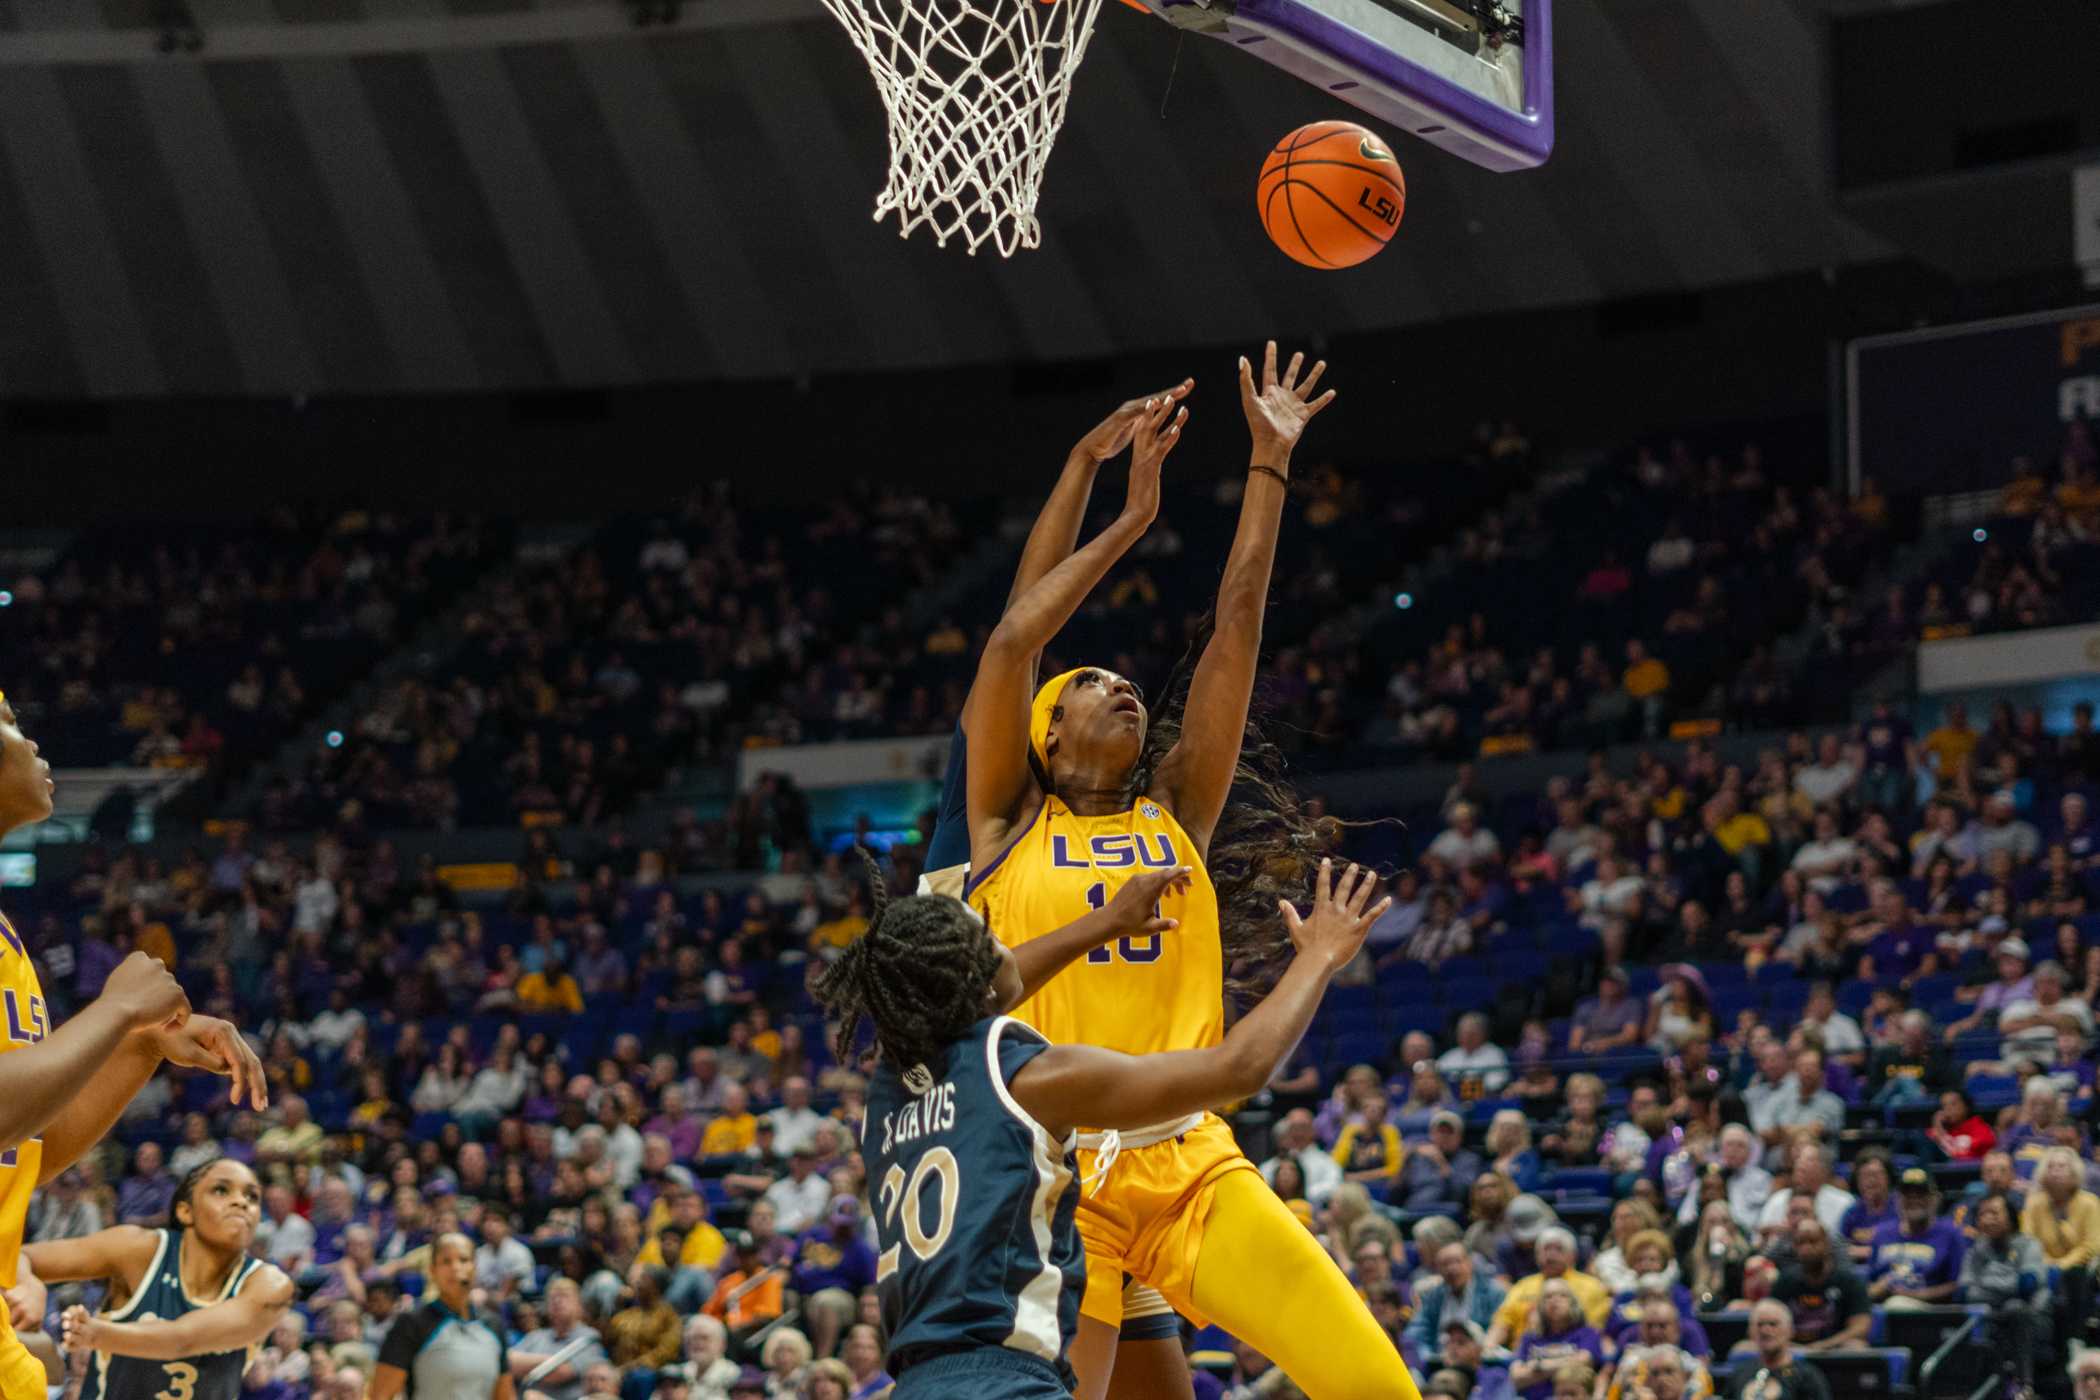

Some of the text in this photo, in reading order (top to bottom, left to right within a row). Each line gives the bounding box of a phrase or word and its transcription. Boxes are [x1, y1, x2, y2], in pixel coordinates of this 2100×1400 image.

[1359, 187, 1399, 226] LSU
[1052, 832, 1178, 869] LSU
[3, 988, 52, 1044] LS
[894, 1081, 956, 1144] DAVIS
[875, 1145, 960, 1284] 20
[154, 1361, 199, 1400] 3
